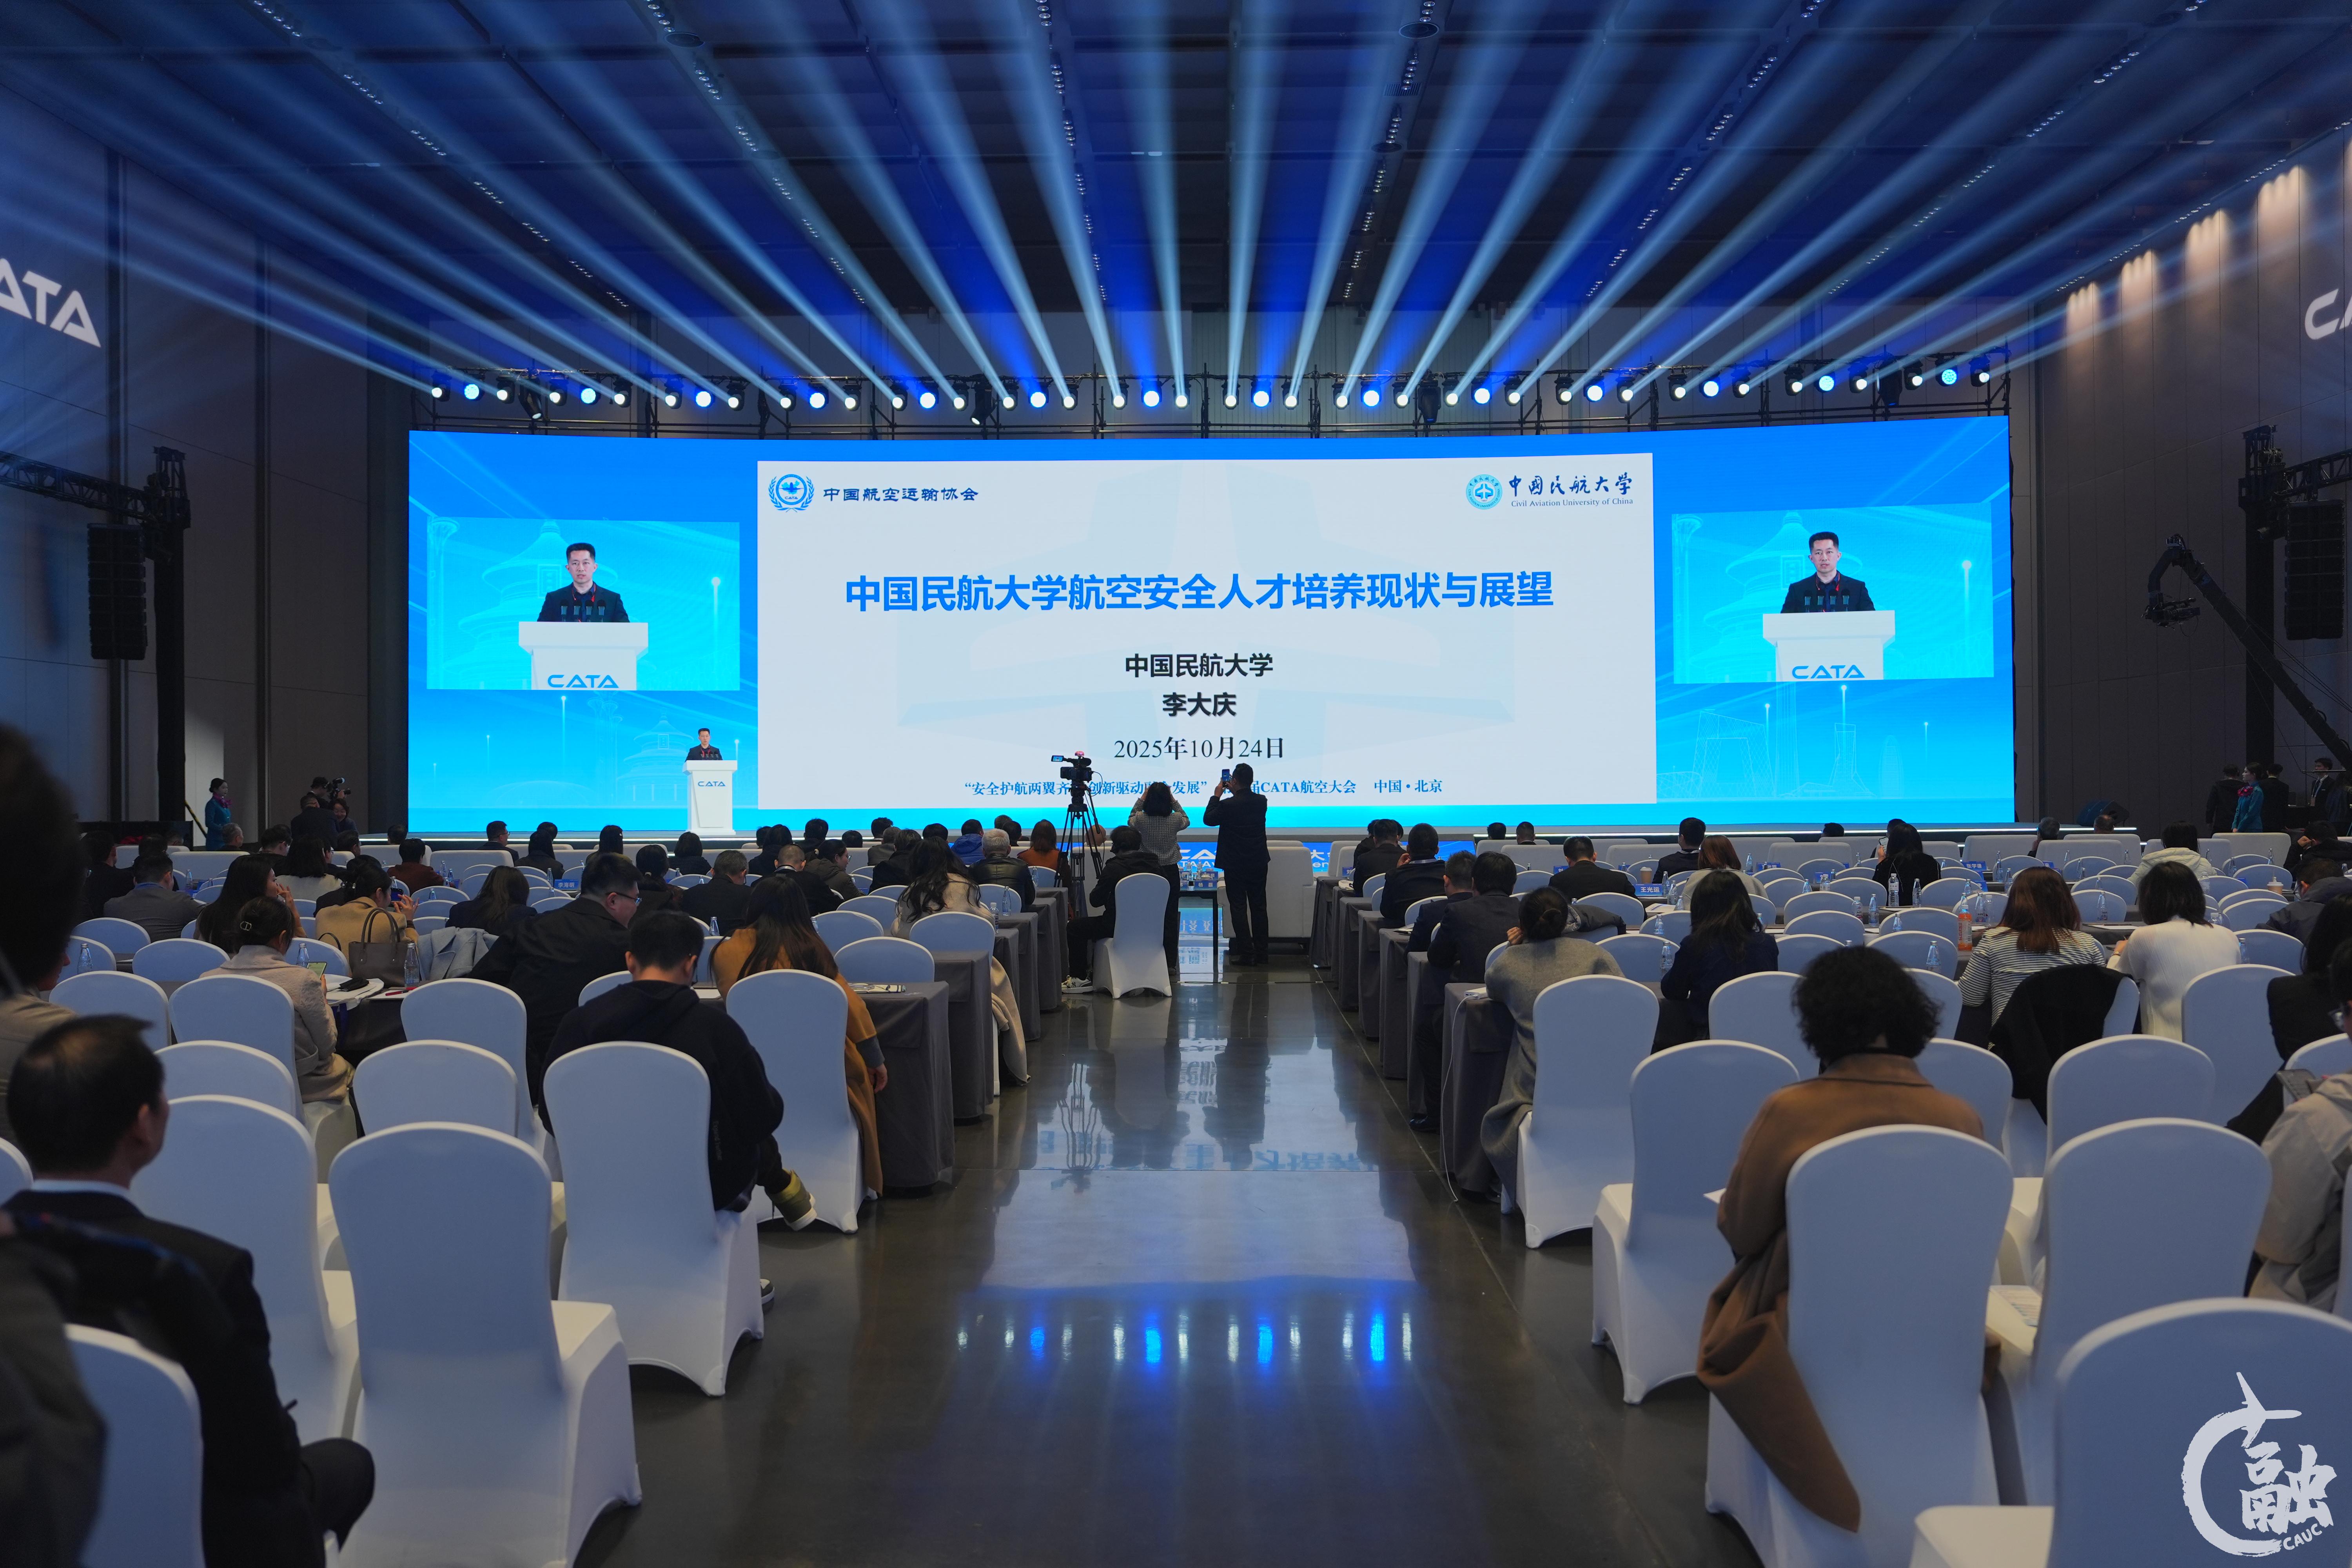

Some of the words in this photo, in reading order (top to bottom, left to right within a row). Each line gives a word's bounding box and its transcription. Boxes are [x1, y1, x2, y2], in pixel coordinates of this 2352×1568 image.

[2305, 289, 2352, 340] C
[823, 487, 979, 502] 中国航空运输协会
[846, 570, 1554, 612] 中国民航大学航空安全人才培养现状与展望
[1125, 653, 1273, 678] 中国民航大学
[1792, 664, 1865, 679] CATA
[548, 675, 619, 688] CATA
[1162, 691, 1237, 717] 李大庆
[1114, 736, 1283, 760] 2025年10月24日
